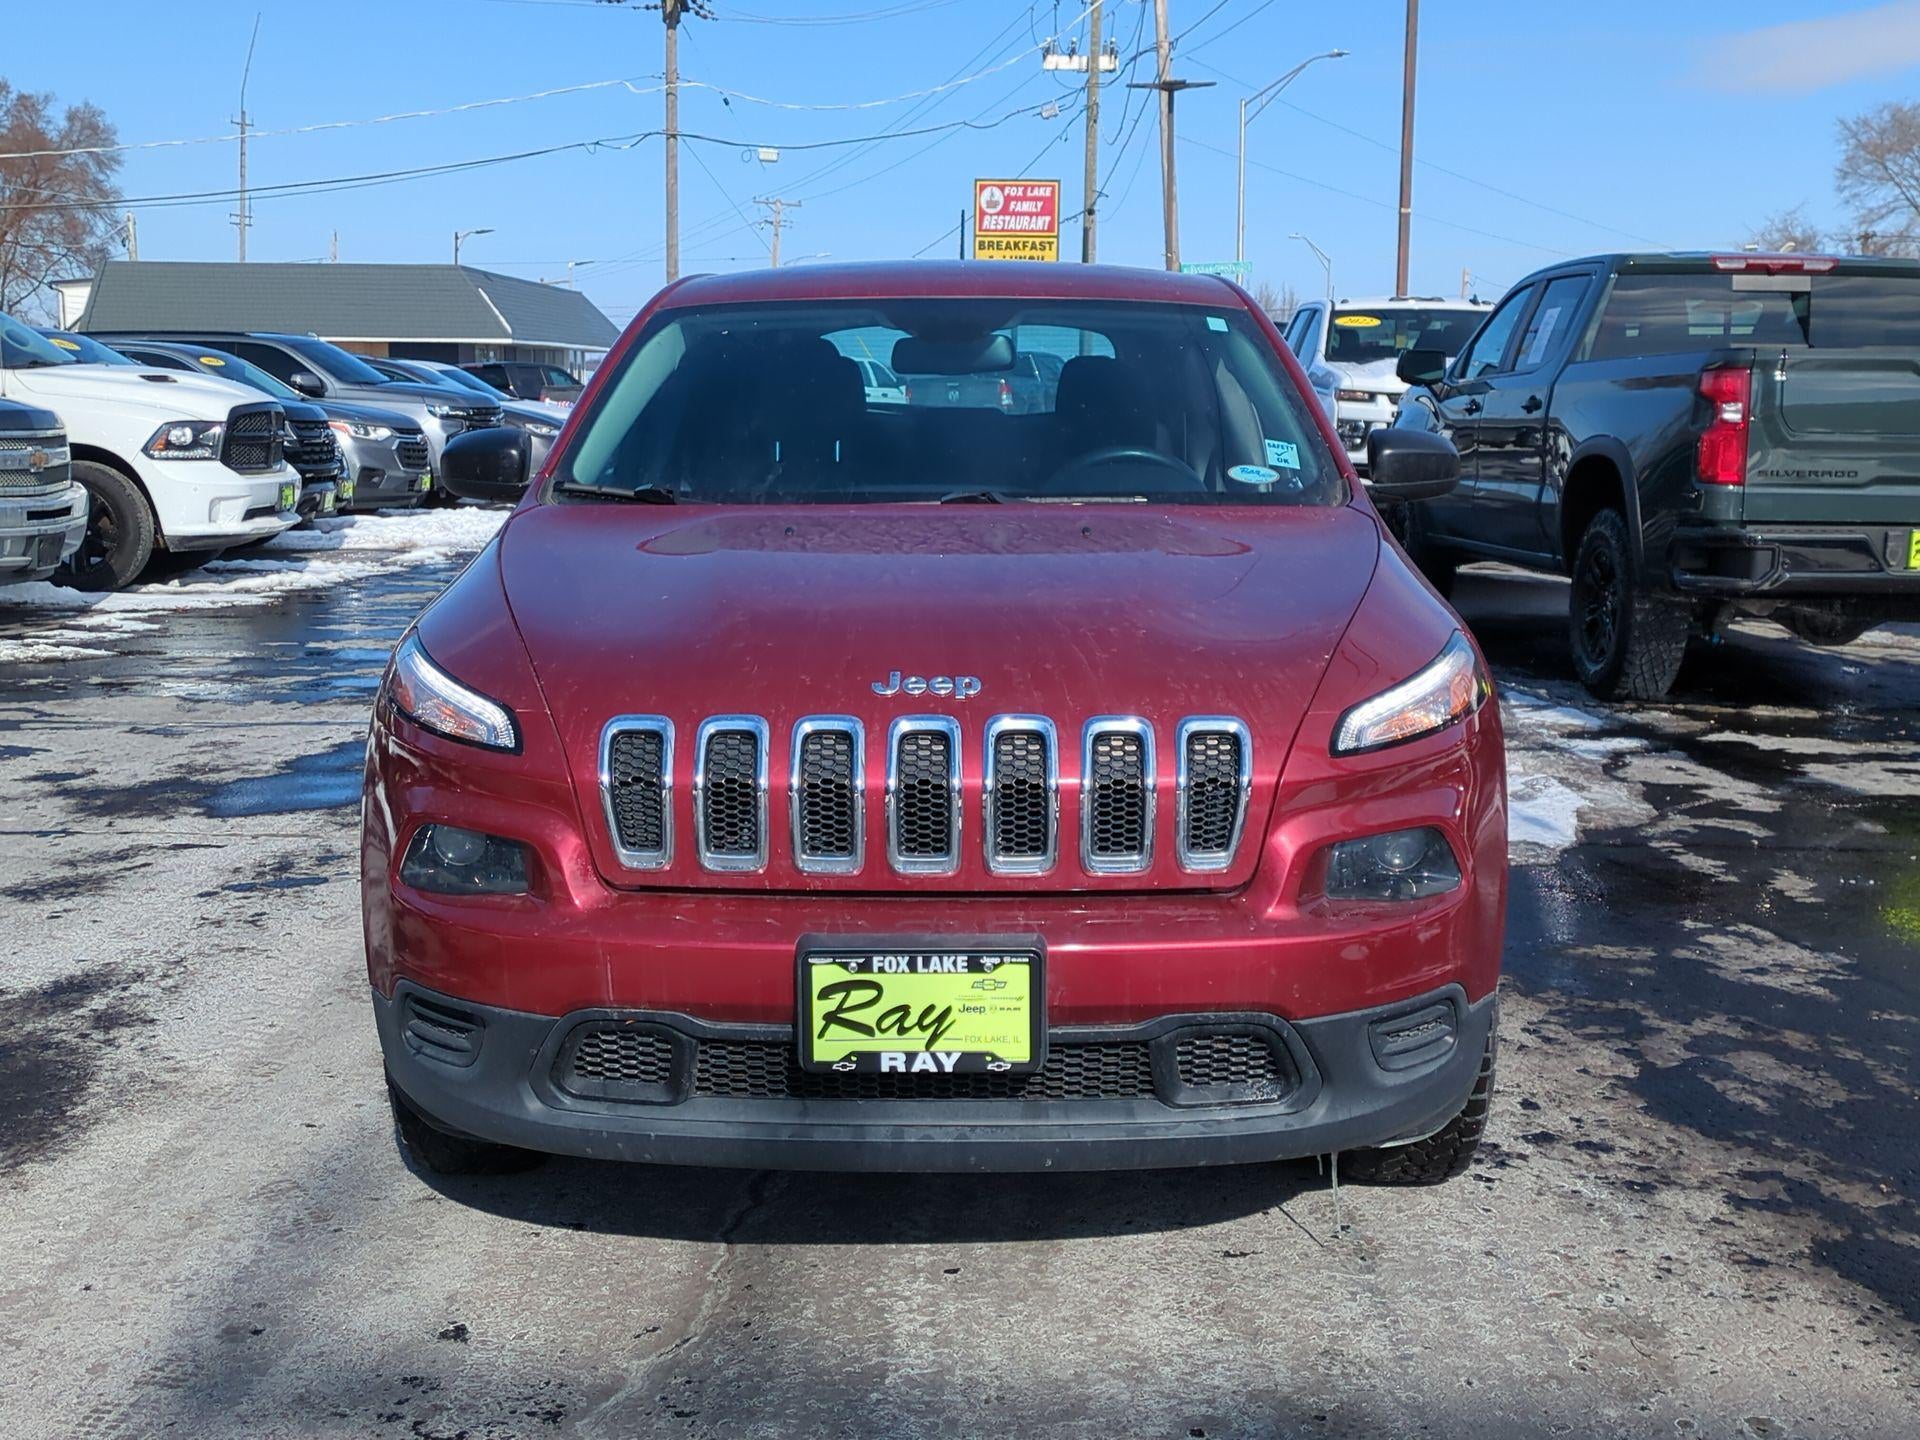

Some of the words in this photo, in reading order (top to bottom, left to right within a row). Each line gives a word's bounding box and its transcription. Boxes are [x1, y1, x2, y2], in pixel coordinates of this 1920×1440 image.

[1004, 187, 1024, 196] FOX
[1027, 187, 1052, 197] LAKE
[1008, 201, 1044, 213] FAMILY
[982, 215, 1051, 230] RESTAURANT
[978, 241, 1054, 251] BREAKFAST
[1268, 442, 1294, 451] SAFETY
[1758, 470, 1858, 478] SILVERADO
[871, 671, 982, 699] Jeep
[872, 956, 910, 973] FOX
[916, 956, 969, 973] LAKE
[980, 956, 1001, 965] Jeep
[816, 979, 957, 1051] Ray
[958, 1003, 987, 1015] Jeep
[964, 1035, 983, 1044] FOX
[984, 1035, 1011, 1044] LAKE,
[1013, 1035, 1022, 1044] IL
[880, 1052, 963, 1073] RAY
